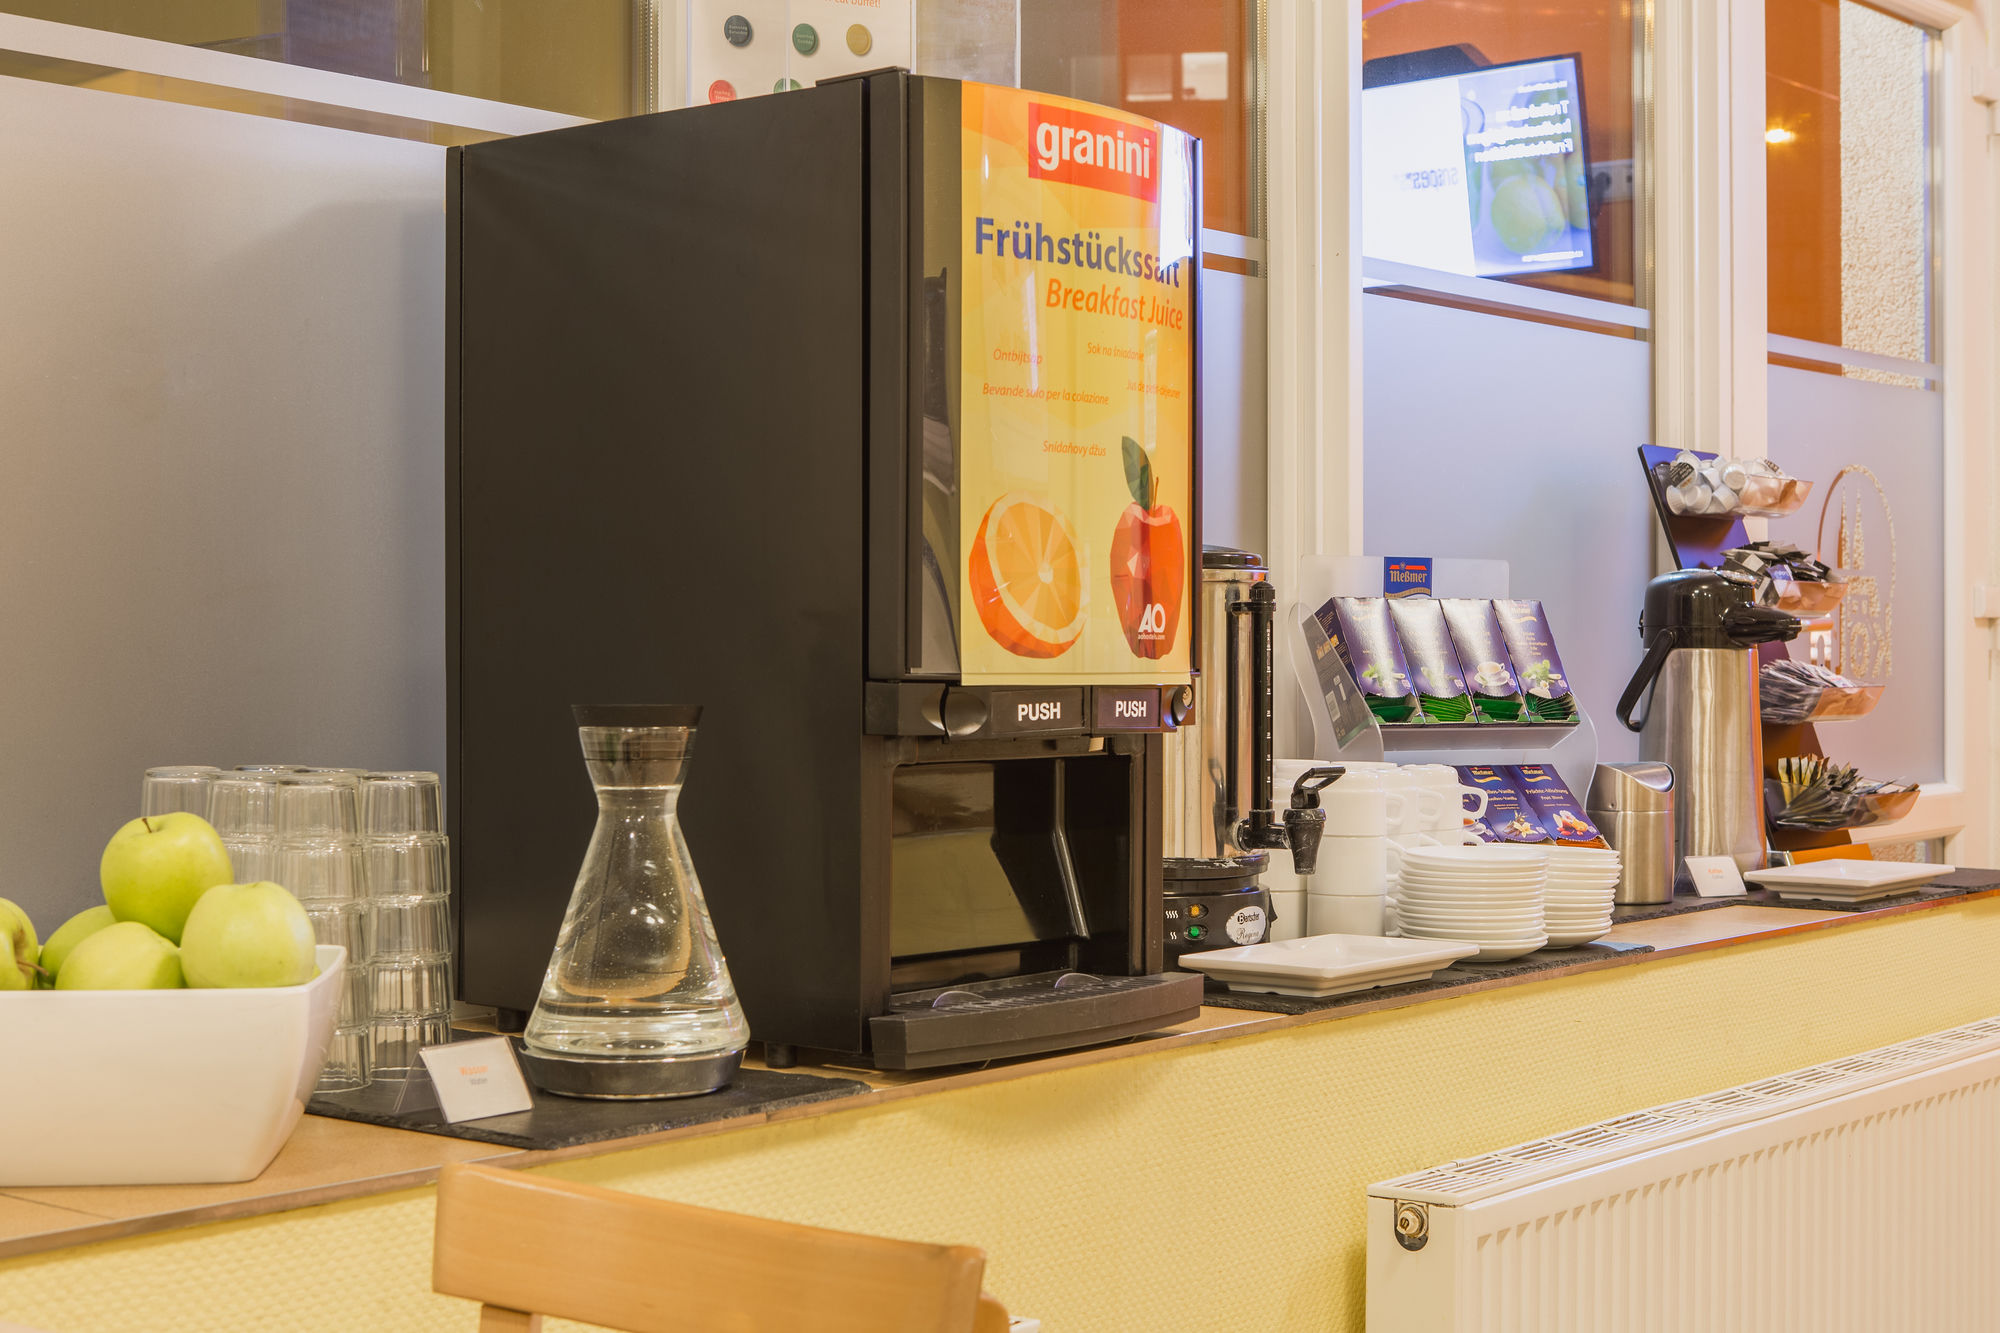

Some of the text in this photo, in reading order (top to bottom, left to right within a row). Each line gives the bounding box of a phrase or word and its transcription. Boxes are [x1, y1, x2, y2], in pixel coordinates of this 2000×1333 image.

[1036, 121, 1150, 179] granini
[1045, 277, 1184, 331] Breakfast Juice
[983, 382, 1024, 398] Bevande
[1046, 391, 1060, 402] per
[1062, 388, 1071, 401] la
[1072, 390, 1109, 406] colazione
[1389, 570, 1428, 583] Meßmer
[1138, 603, 1166, 633] AO
[1018, 702, 1061, 721] PUSH
[1115, 700, 1147, 718] PUSH
